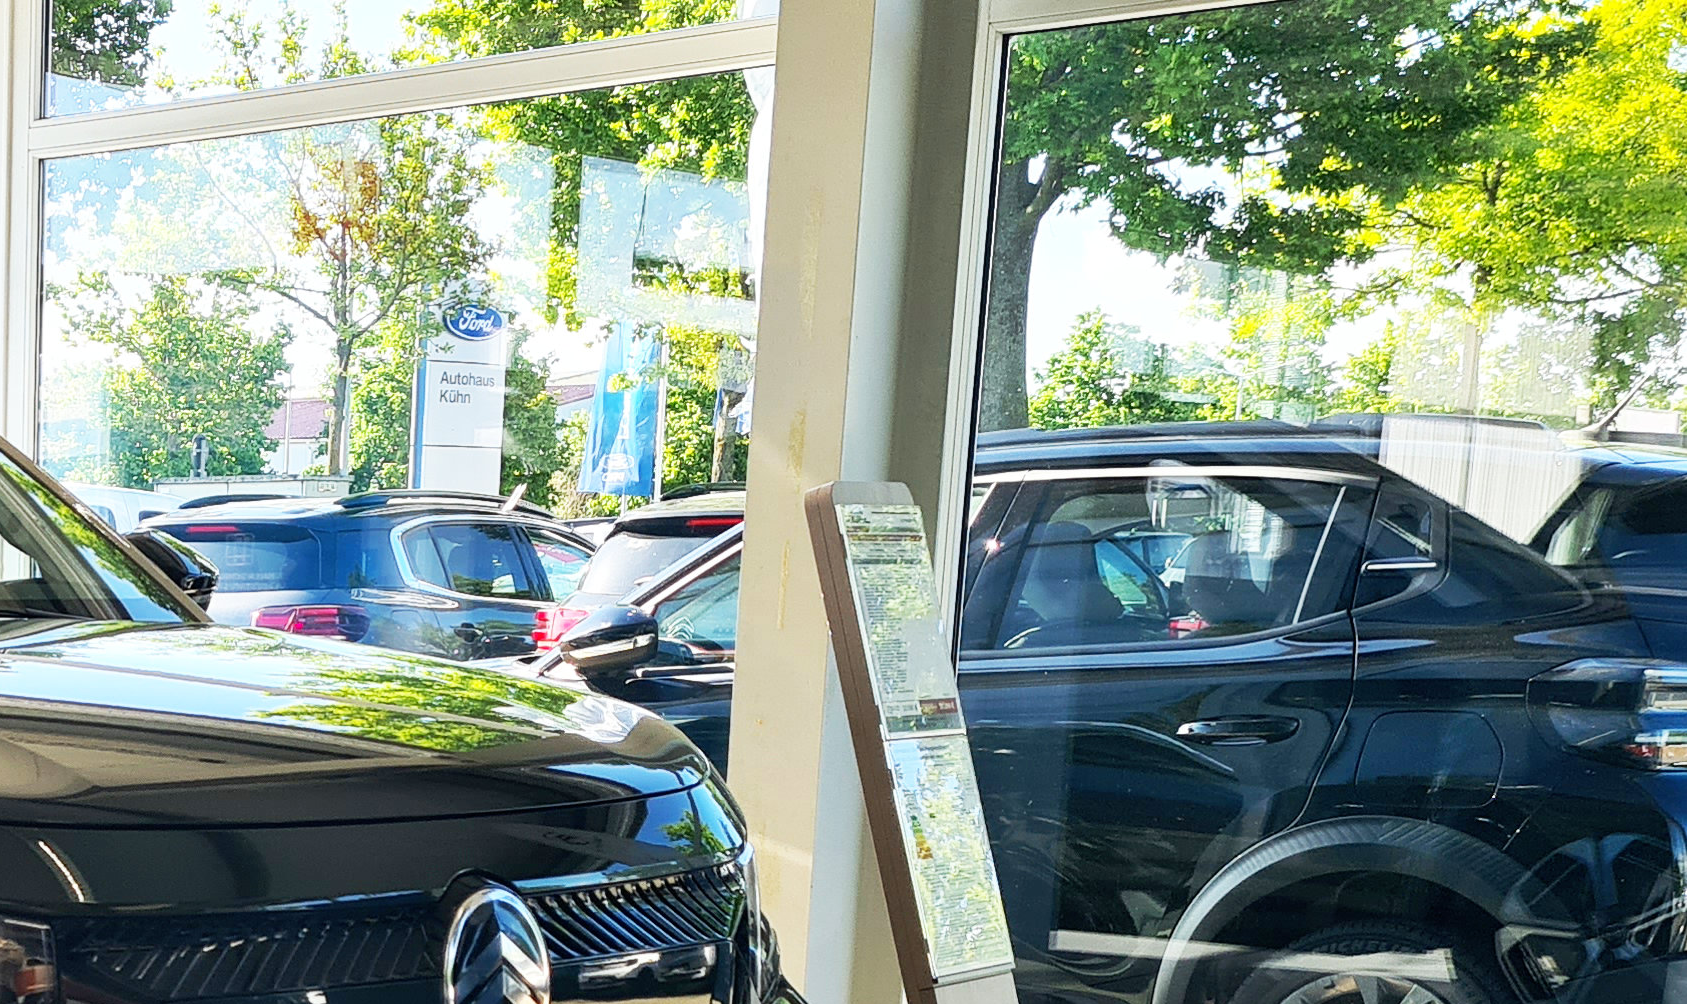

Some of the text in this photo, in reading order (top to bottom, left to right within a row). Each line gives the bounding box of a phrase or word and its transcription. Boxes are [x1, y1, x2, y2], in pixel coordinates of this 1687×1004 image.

[458, 306, 495, 333] Ford
[439, 371, 495, 387] Autohaus
[439, 389, 471, 404] Kühn
